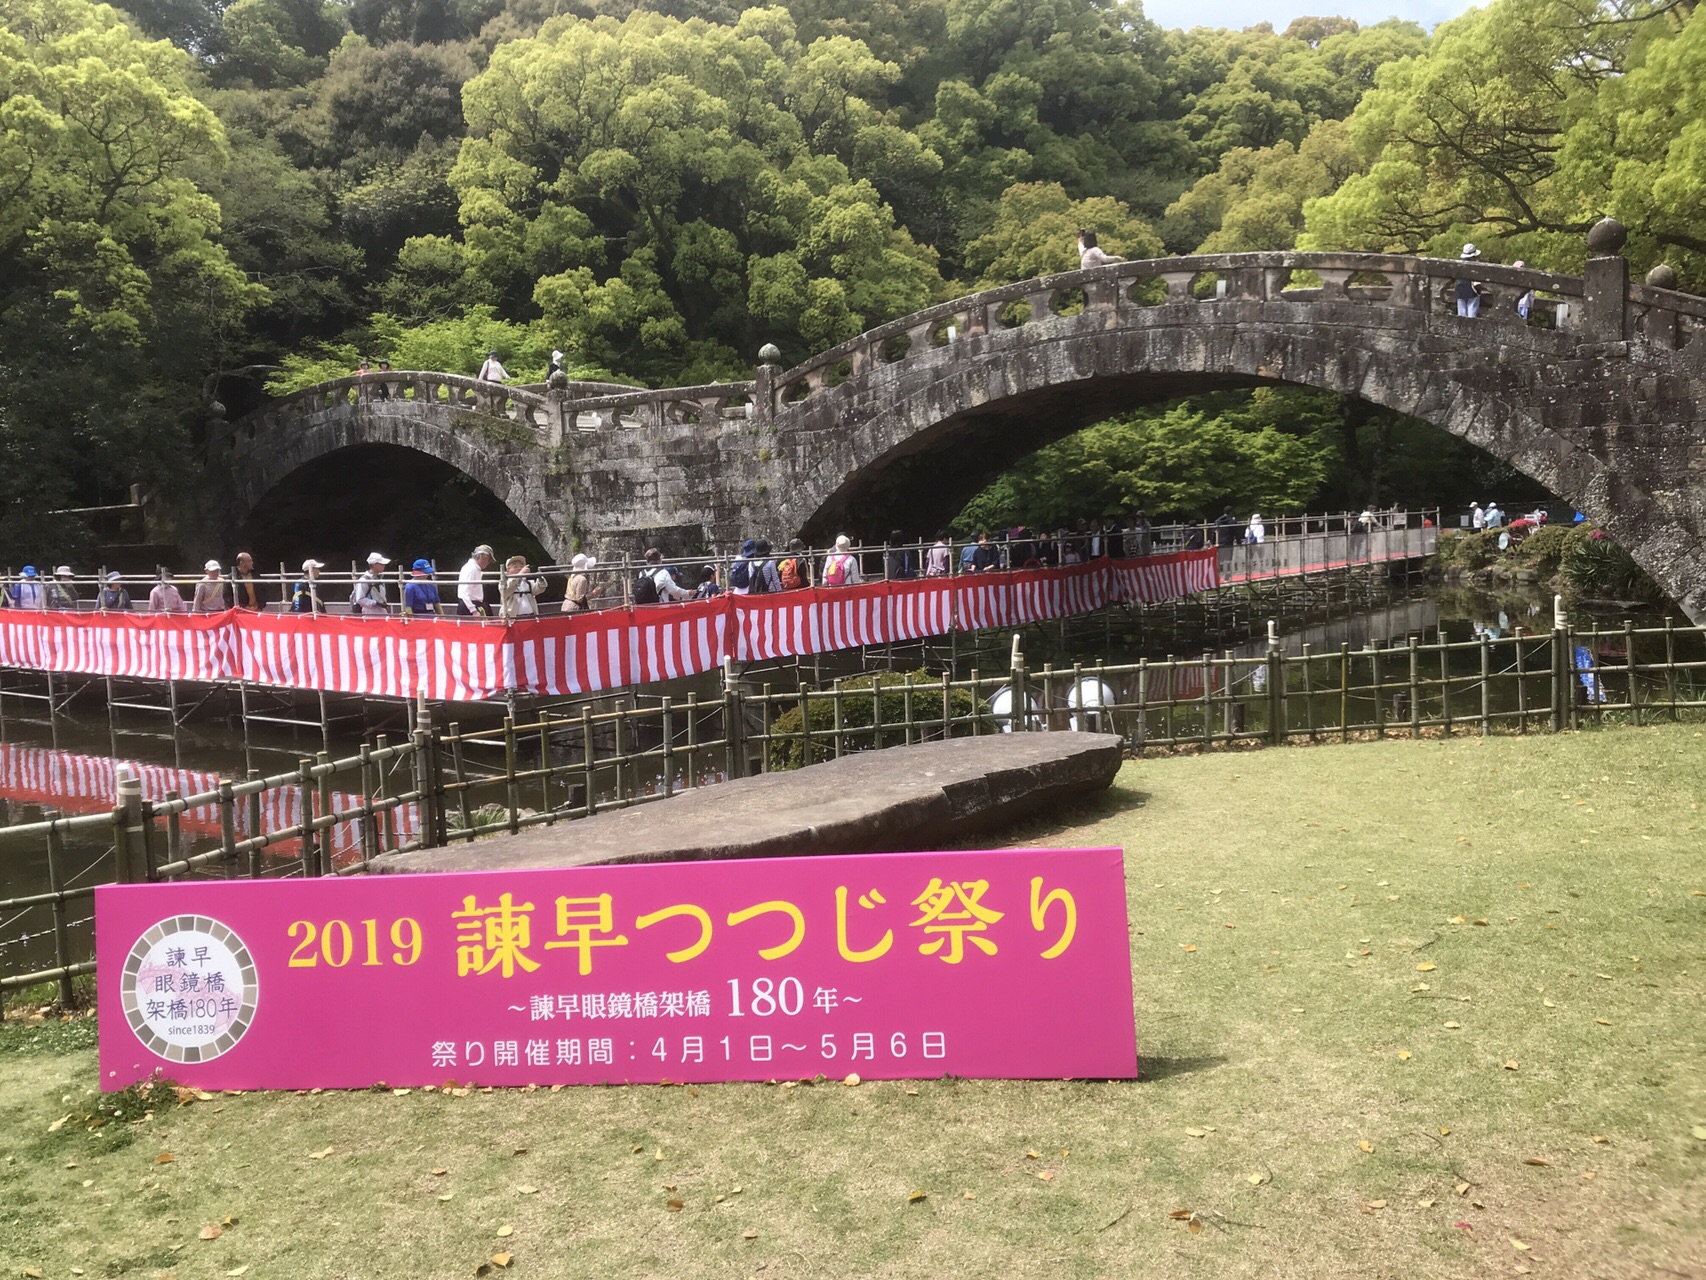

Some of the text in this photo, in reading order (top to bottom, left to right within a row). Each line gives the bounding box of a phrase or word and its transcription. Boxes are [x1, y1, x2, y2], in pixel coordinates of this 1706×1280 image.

[287, 876, 1077, 979] 2019 諫早つつじ祭り
[165, 946, 212, 968] 諫早
[155, 971, 226, 994] 眼鏡橋
[146, 996, 238, 1021] 架橋180年
[168, 1024, 215, 1035] since1839
